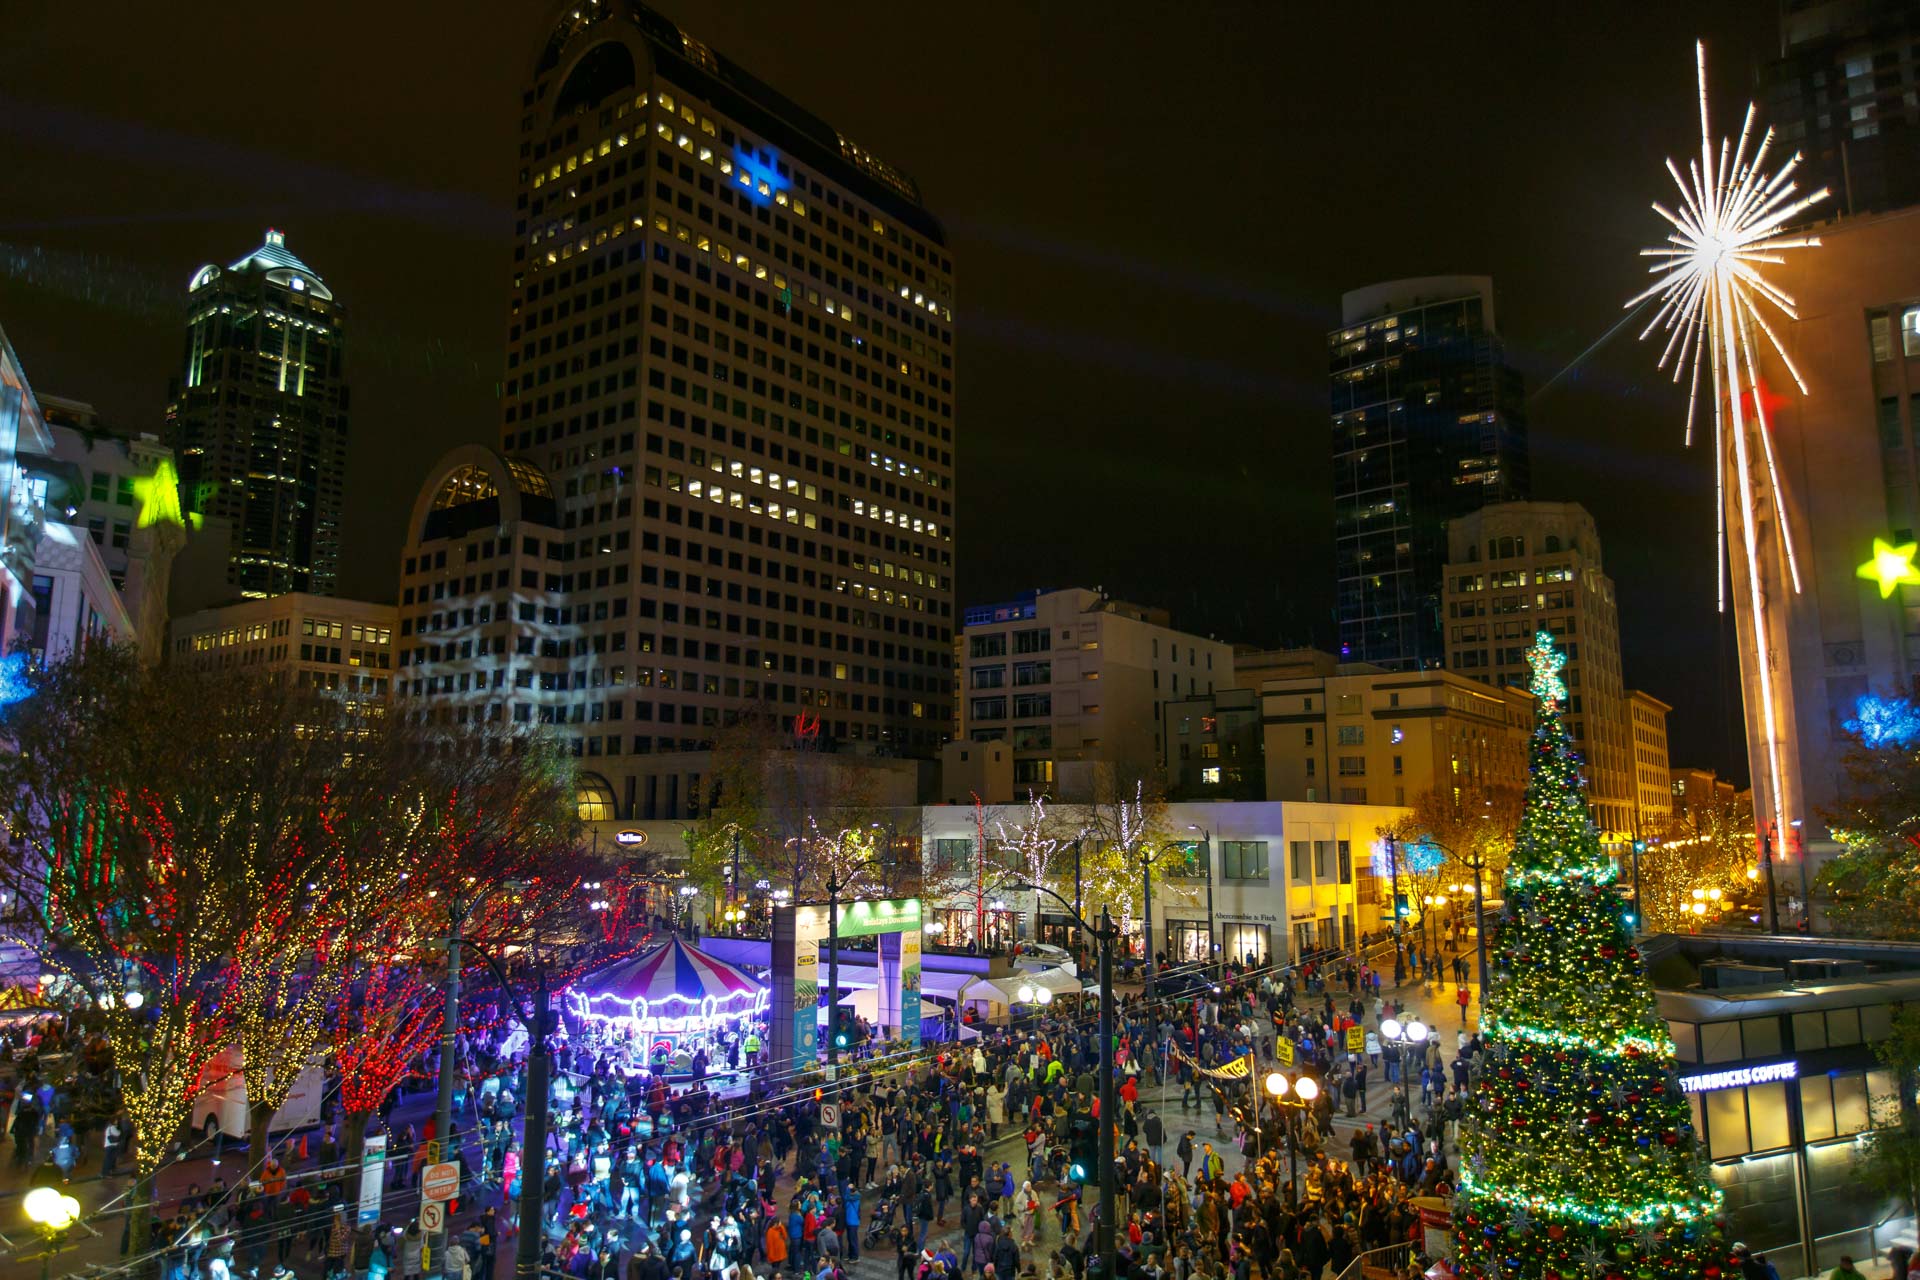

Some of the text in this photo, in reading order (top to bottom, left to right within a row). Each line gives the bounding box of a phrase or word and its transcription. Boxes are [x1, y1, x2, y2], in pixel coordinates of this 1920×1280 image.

[863, 915, 918, 926] Holidays Downtown
[1215, 912, 1252, 920] Abercrombie
[1679, 1062, 1797, 1092] STARBUCKS COFFEE
[430, 1168, 454, 1179] DO NOT
[429, 1186, 452, 1195] ENTER
